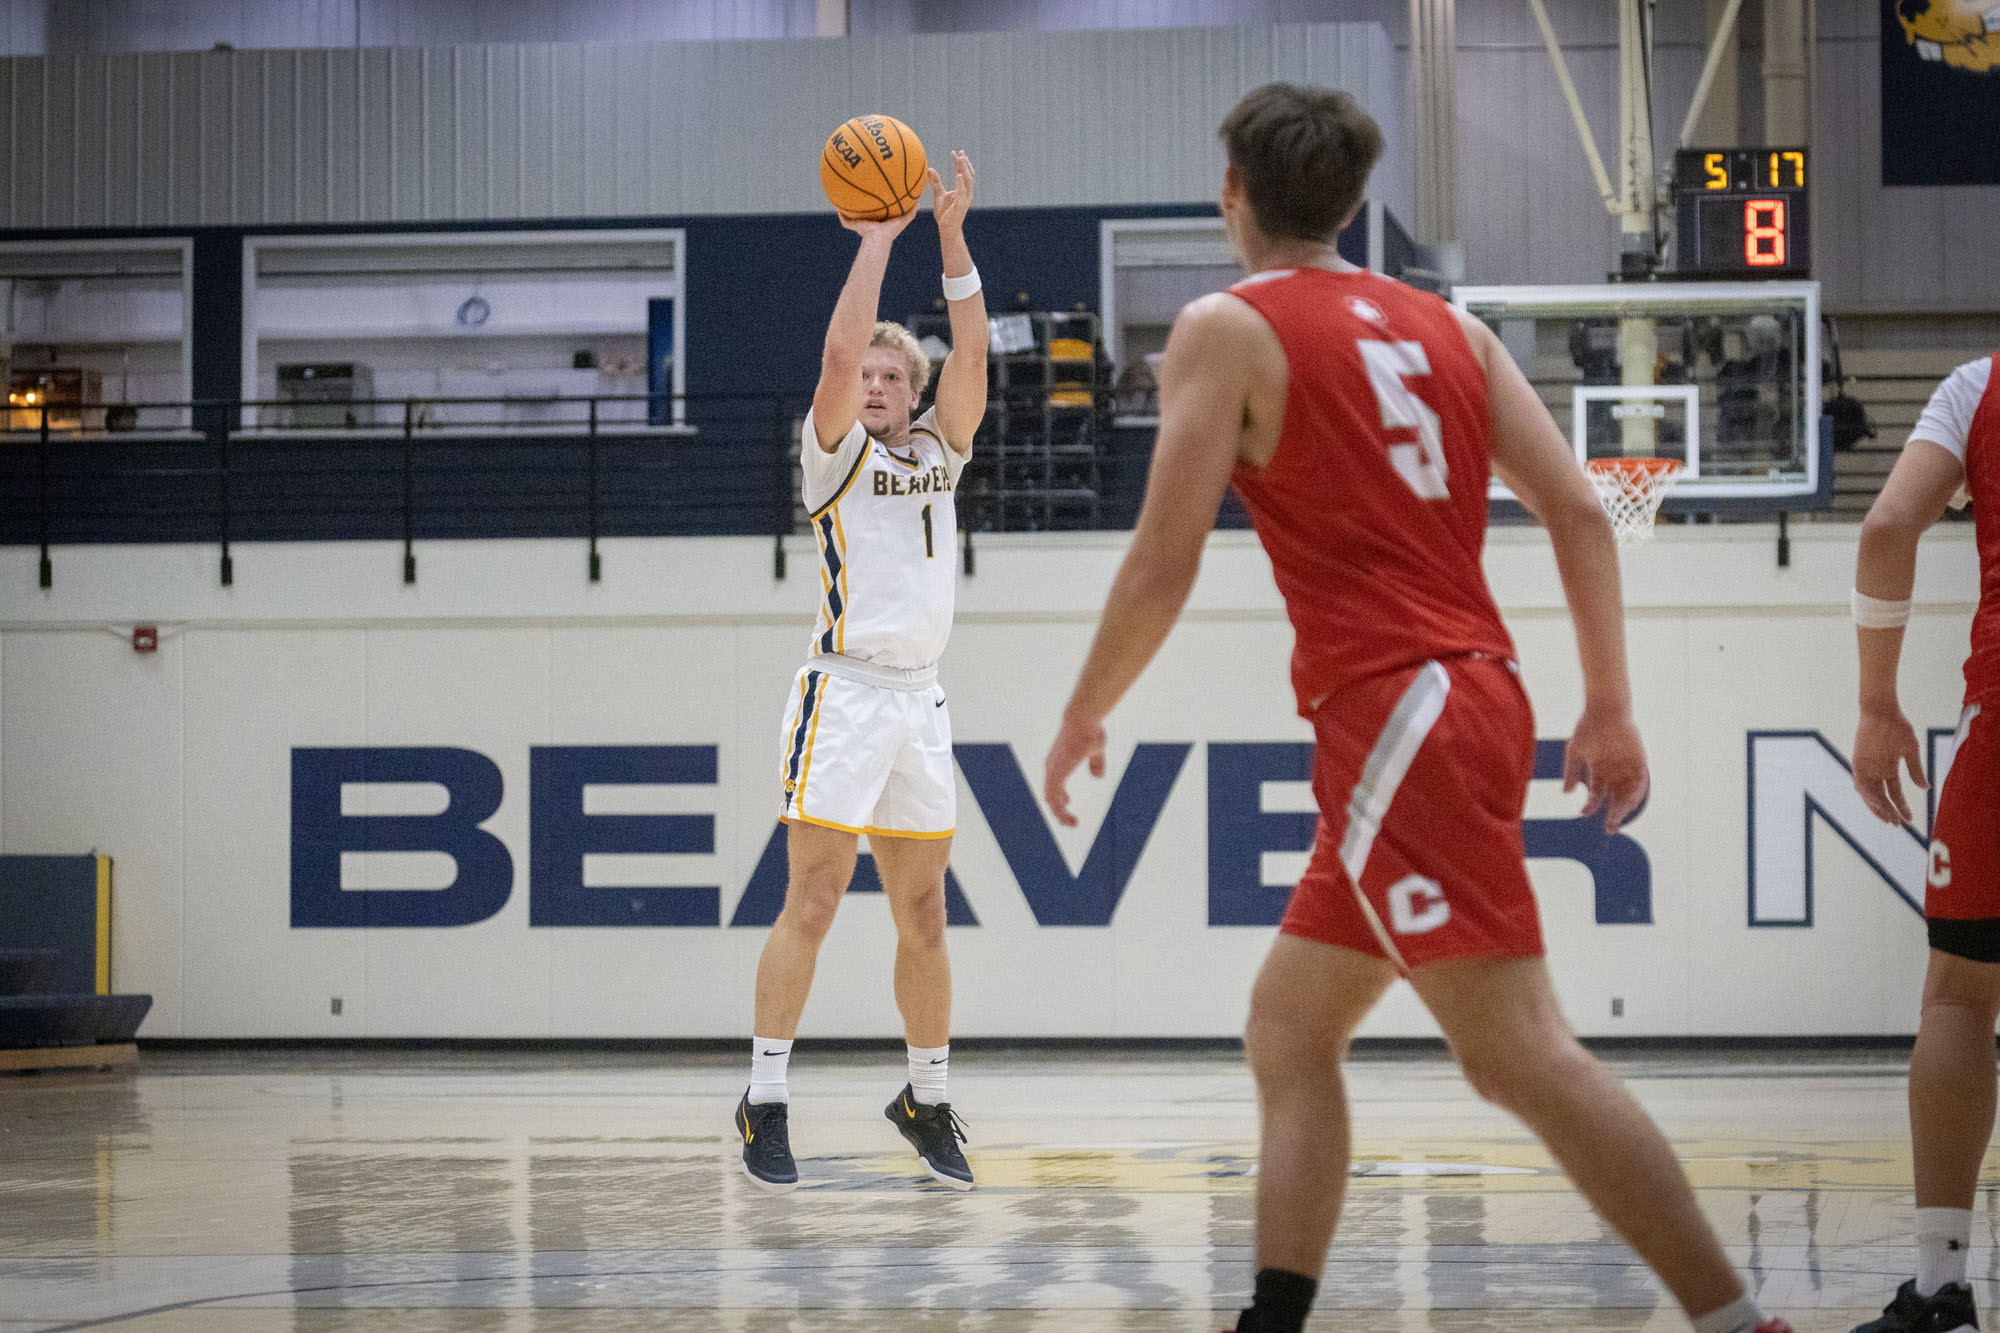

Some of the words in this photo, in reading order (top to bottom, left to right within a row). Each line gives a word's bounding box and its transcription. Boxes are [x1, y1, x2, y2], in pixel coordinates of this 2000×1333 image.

[831, 132, 862, 168] NCAA
[1744, 199, 1785, 266] 8
[1357, 339, 1450, 500] 5
[921, 503, 934, 559] 1
[290, 740, 1655, 928] BEVE
[1928, 839, 1951, 888] C
[1388, 874, 1451, 933] C
